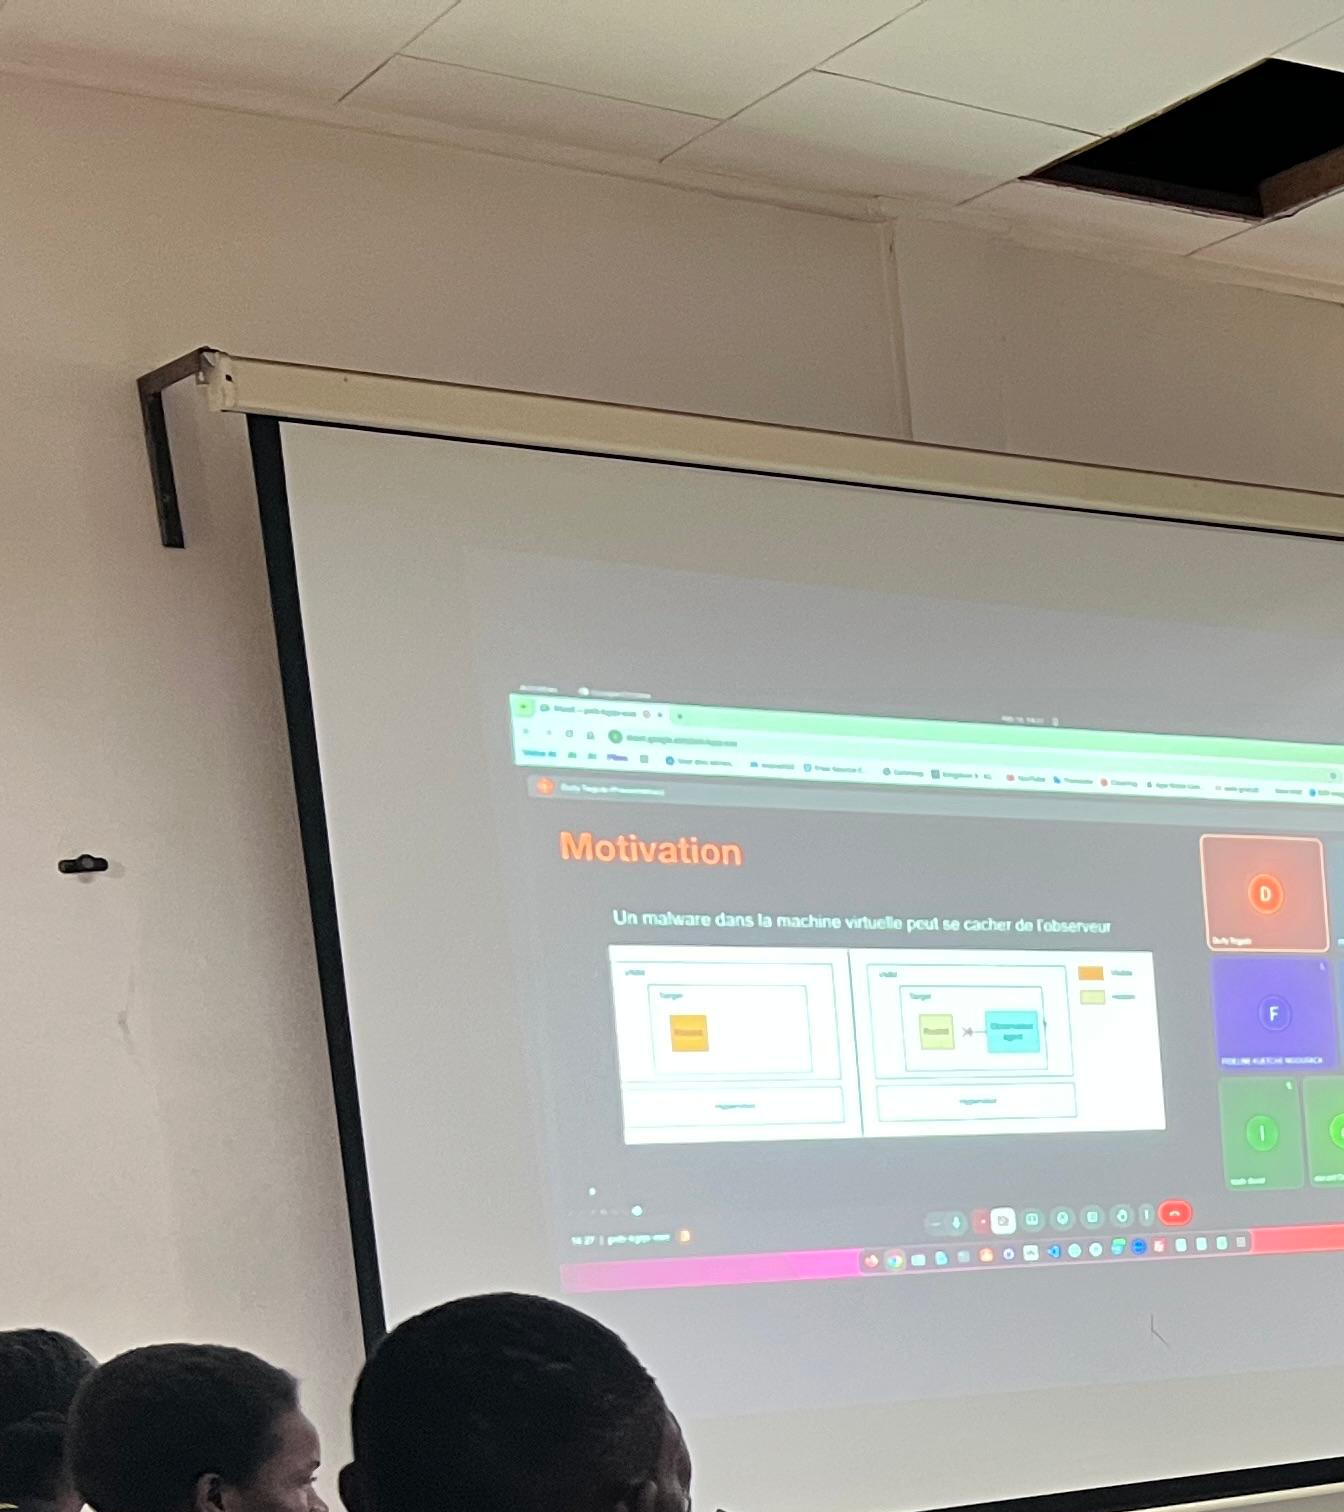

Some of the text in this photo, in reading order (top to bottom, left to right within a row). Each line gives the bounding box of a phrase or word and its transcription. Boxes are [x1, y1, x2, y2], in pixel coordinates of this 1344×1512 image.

[559, 830, 743, 867] Motivation
[1259, 885, 1272, 903] D
[612, 909, 1112, 934] Un malware dans la machine virtuelle peut se cacher de l'observeur
[1269, 1005, 1280, 1022] F
